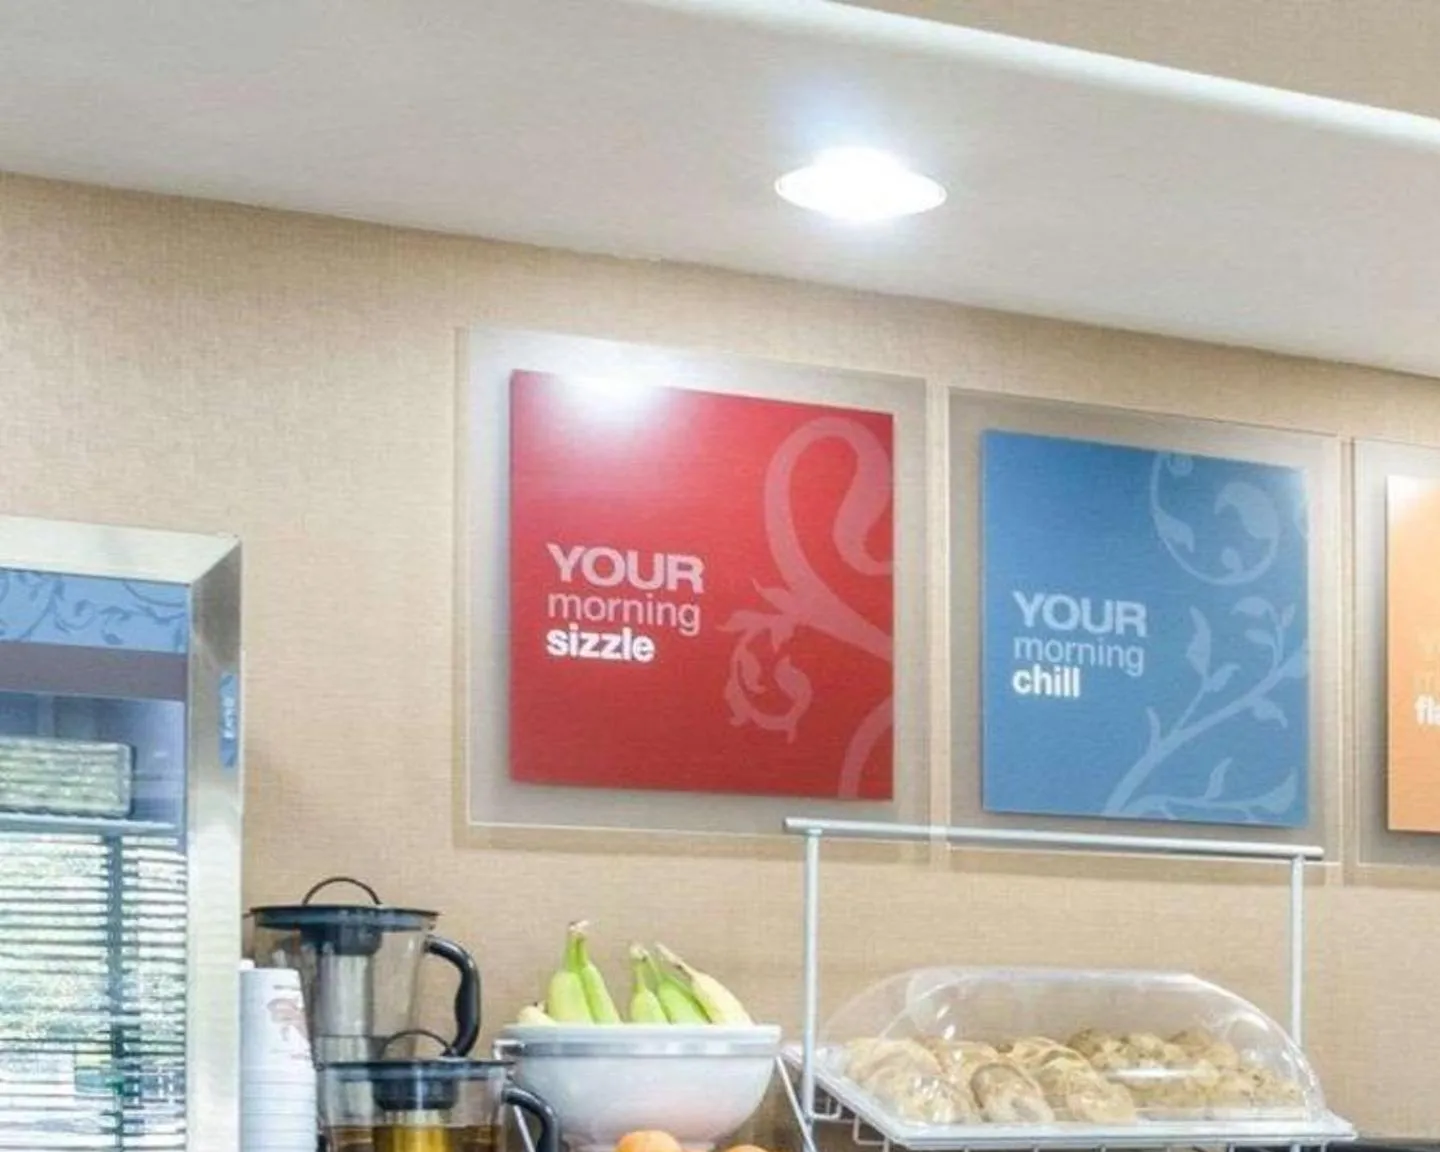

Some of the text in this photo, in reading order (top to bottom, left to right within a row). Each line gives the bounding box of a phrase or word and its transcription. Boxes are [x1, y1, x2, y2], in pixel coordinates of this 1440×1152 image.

[547, 544, 704, 592] YOUR
[549, 593, 700, 635] morning
[1013, 591, 1147, 637] YOUR
[546, 623, 655, 662] sizzle
[1013, 636, 1145, 676] morning
[1012, 664, 1080, 698] chill
